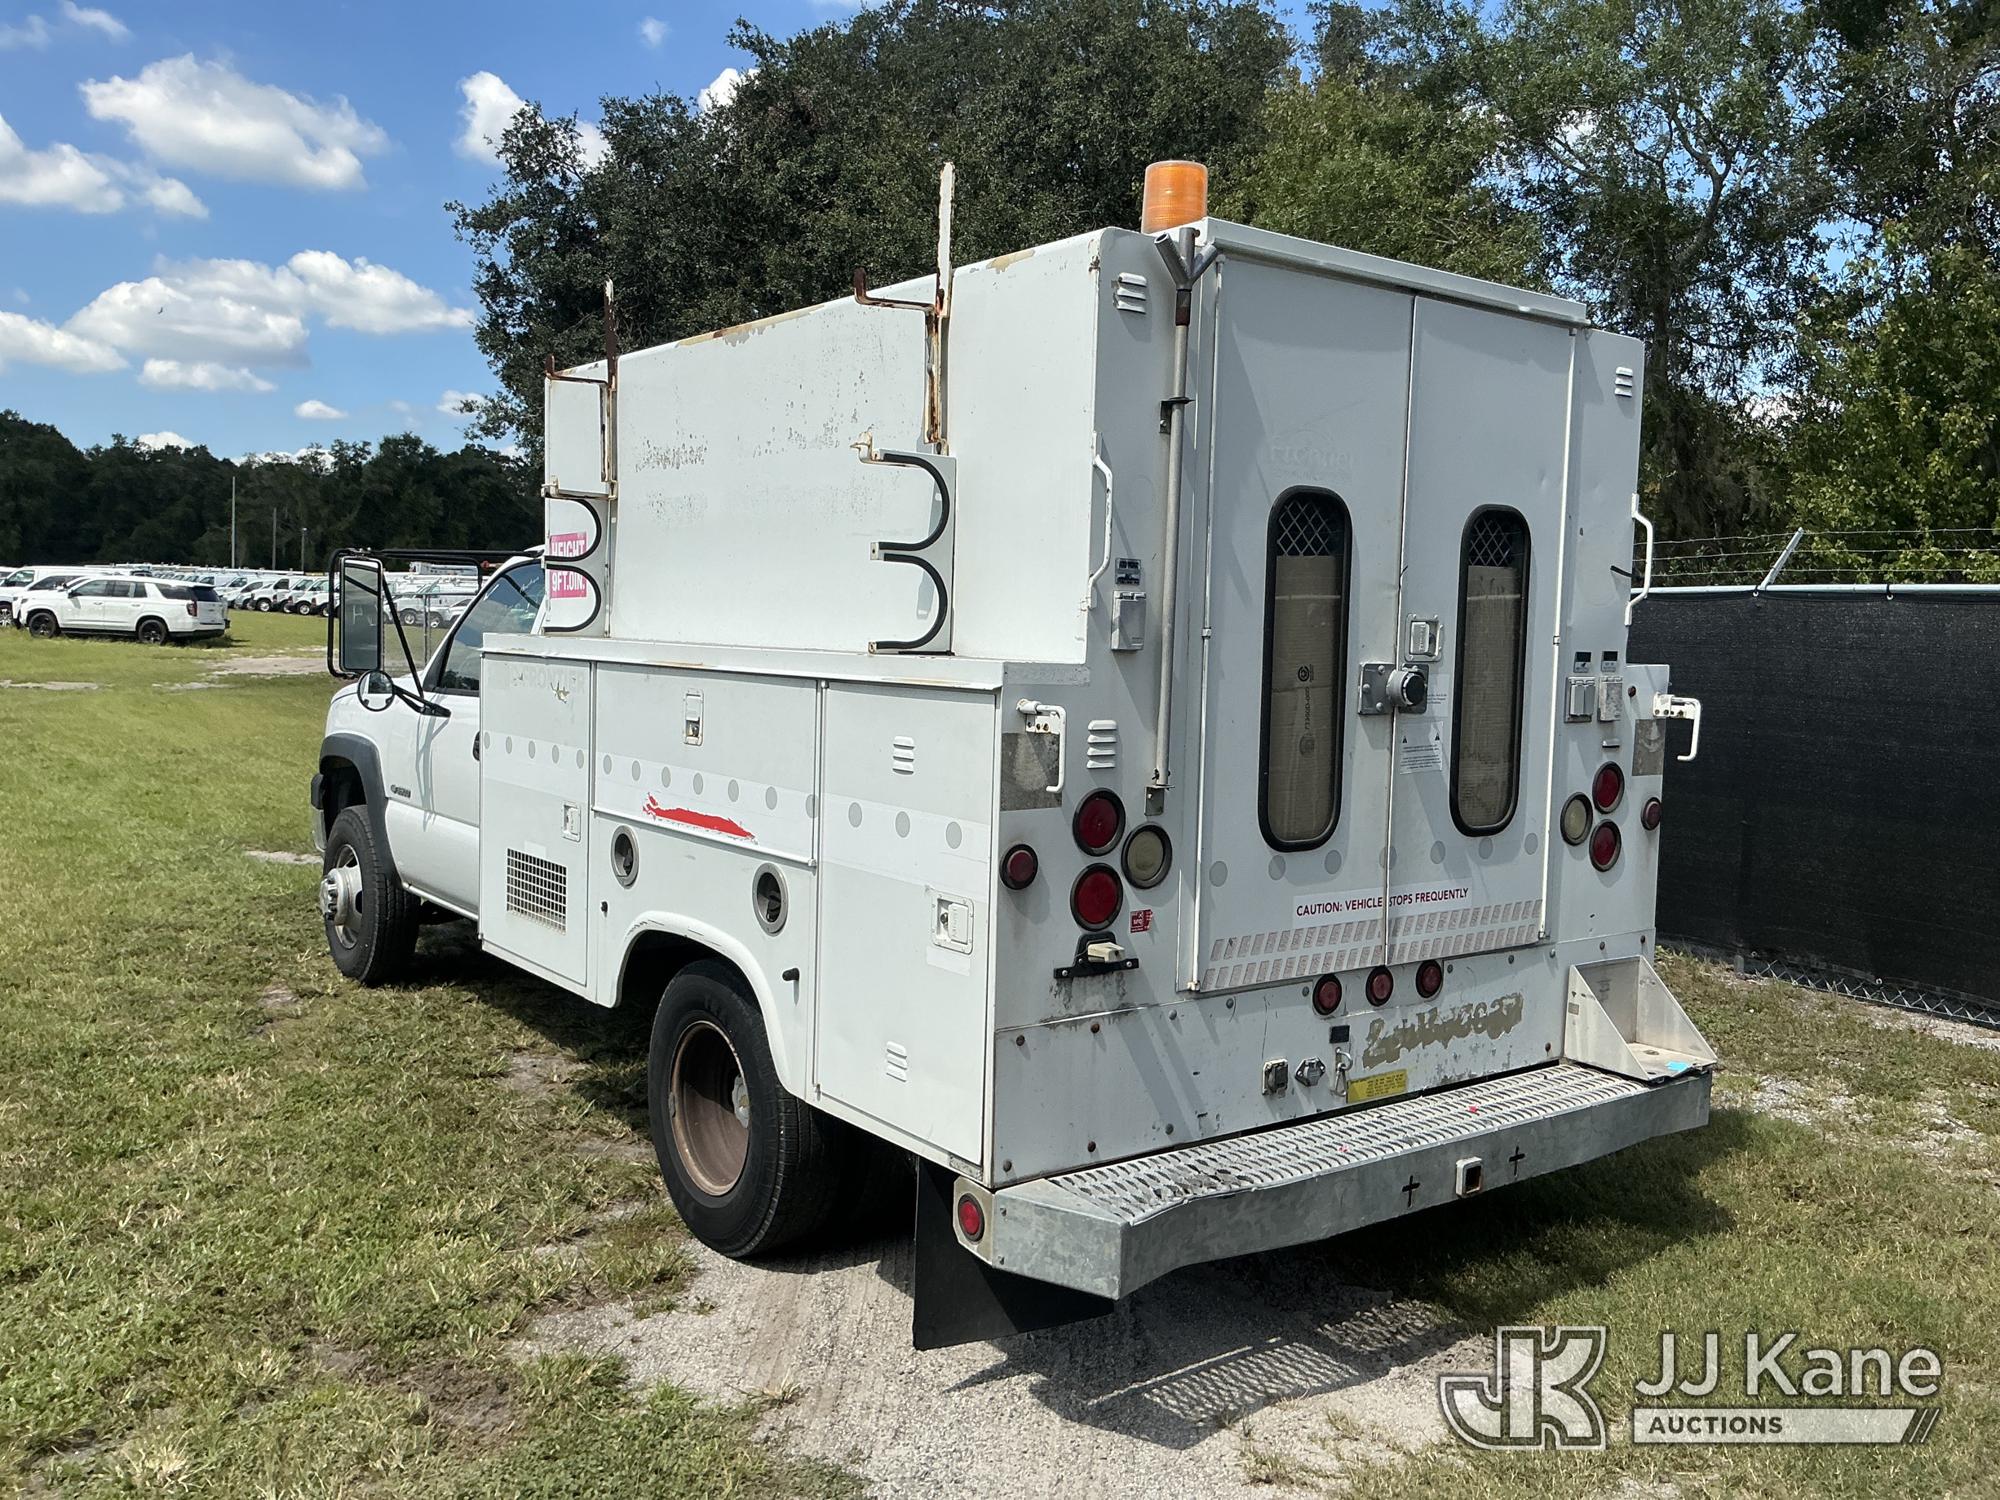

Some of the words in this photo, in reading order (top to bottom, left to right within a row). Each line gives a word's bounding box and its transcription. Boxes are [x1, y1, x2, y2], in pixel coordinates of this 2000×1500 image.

[551, 539, 586, 558] HEIGHT
[1296, 901, 1343, 917] CAUTION:
[1344, 896, 1383, 911] VEHICLE
[1388, 893, 1413, 907] STOPS
[1414, 887, 1470, 904] FREQUENTLY
